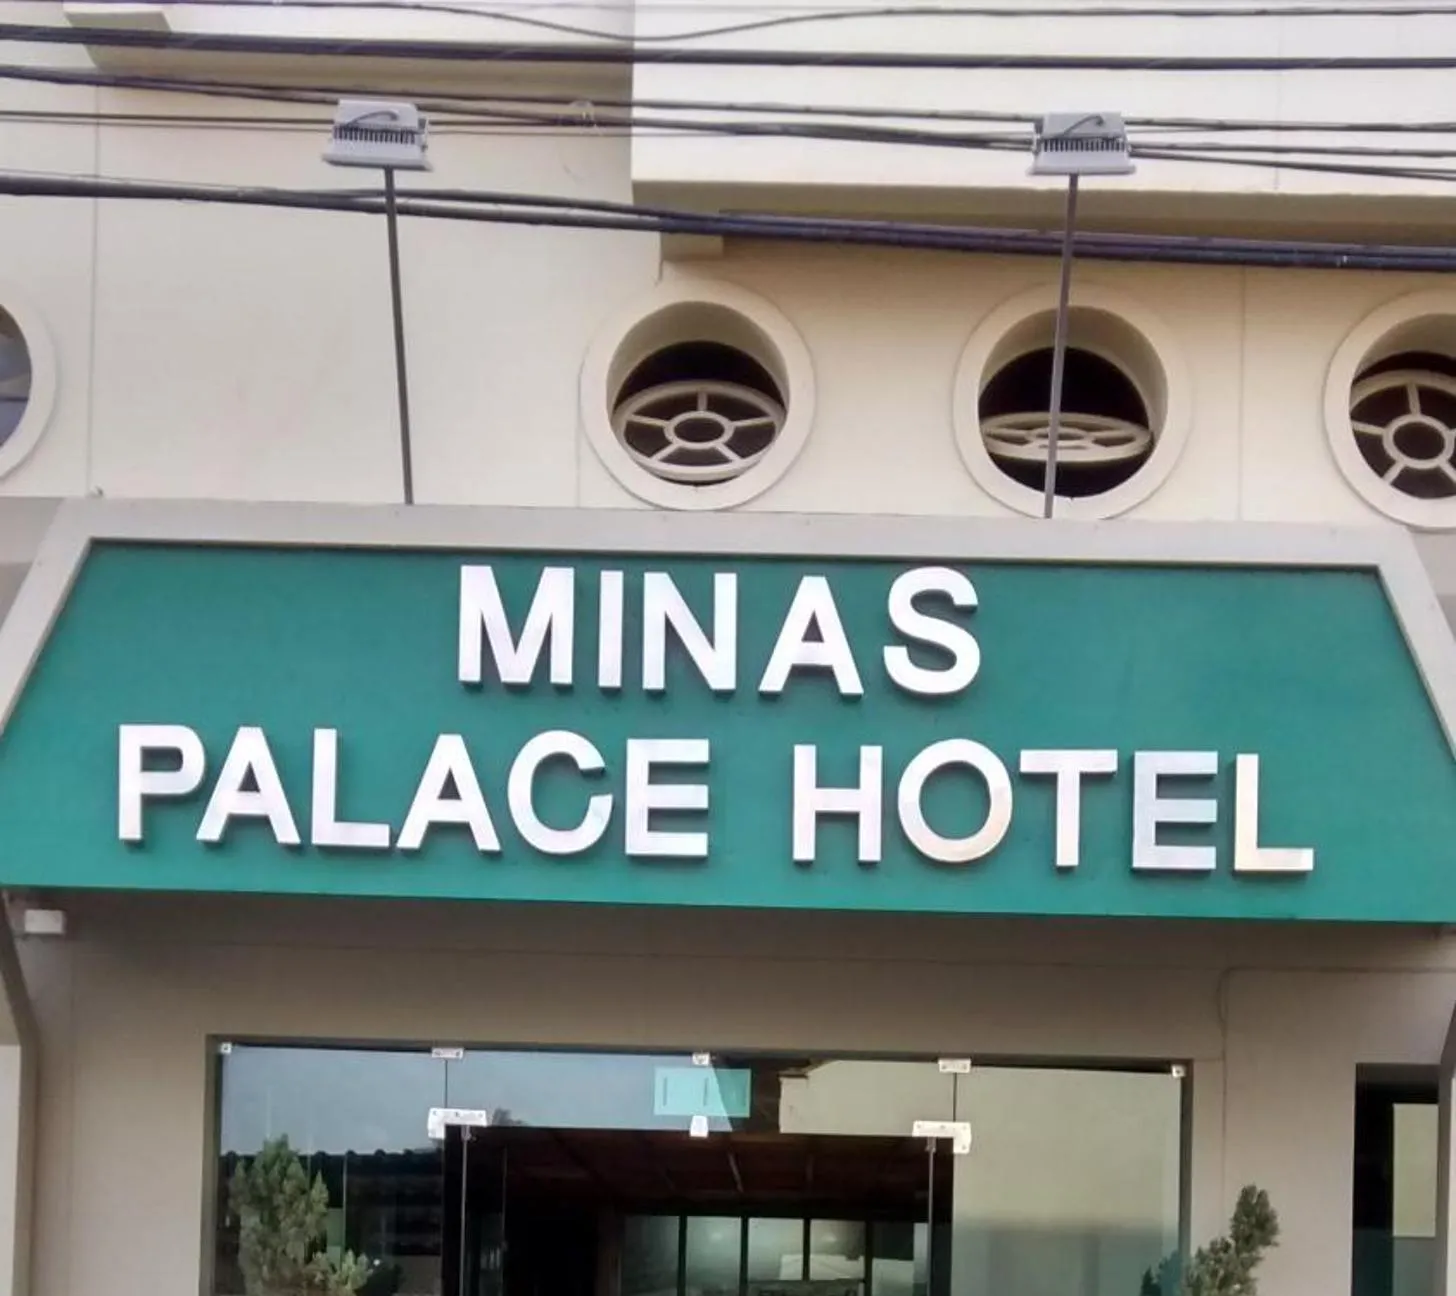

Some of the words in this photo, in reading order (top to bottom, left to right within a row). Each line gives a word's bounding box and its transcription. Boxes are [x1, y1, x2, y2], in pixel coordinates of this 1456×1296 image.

[457, 564, 983, 697] MINAS
[116, 723, 711, 858] PALACE
[791, 738, 1316, 873] HOTEL
